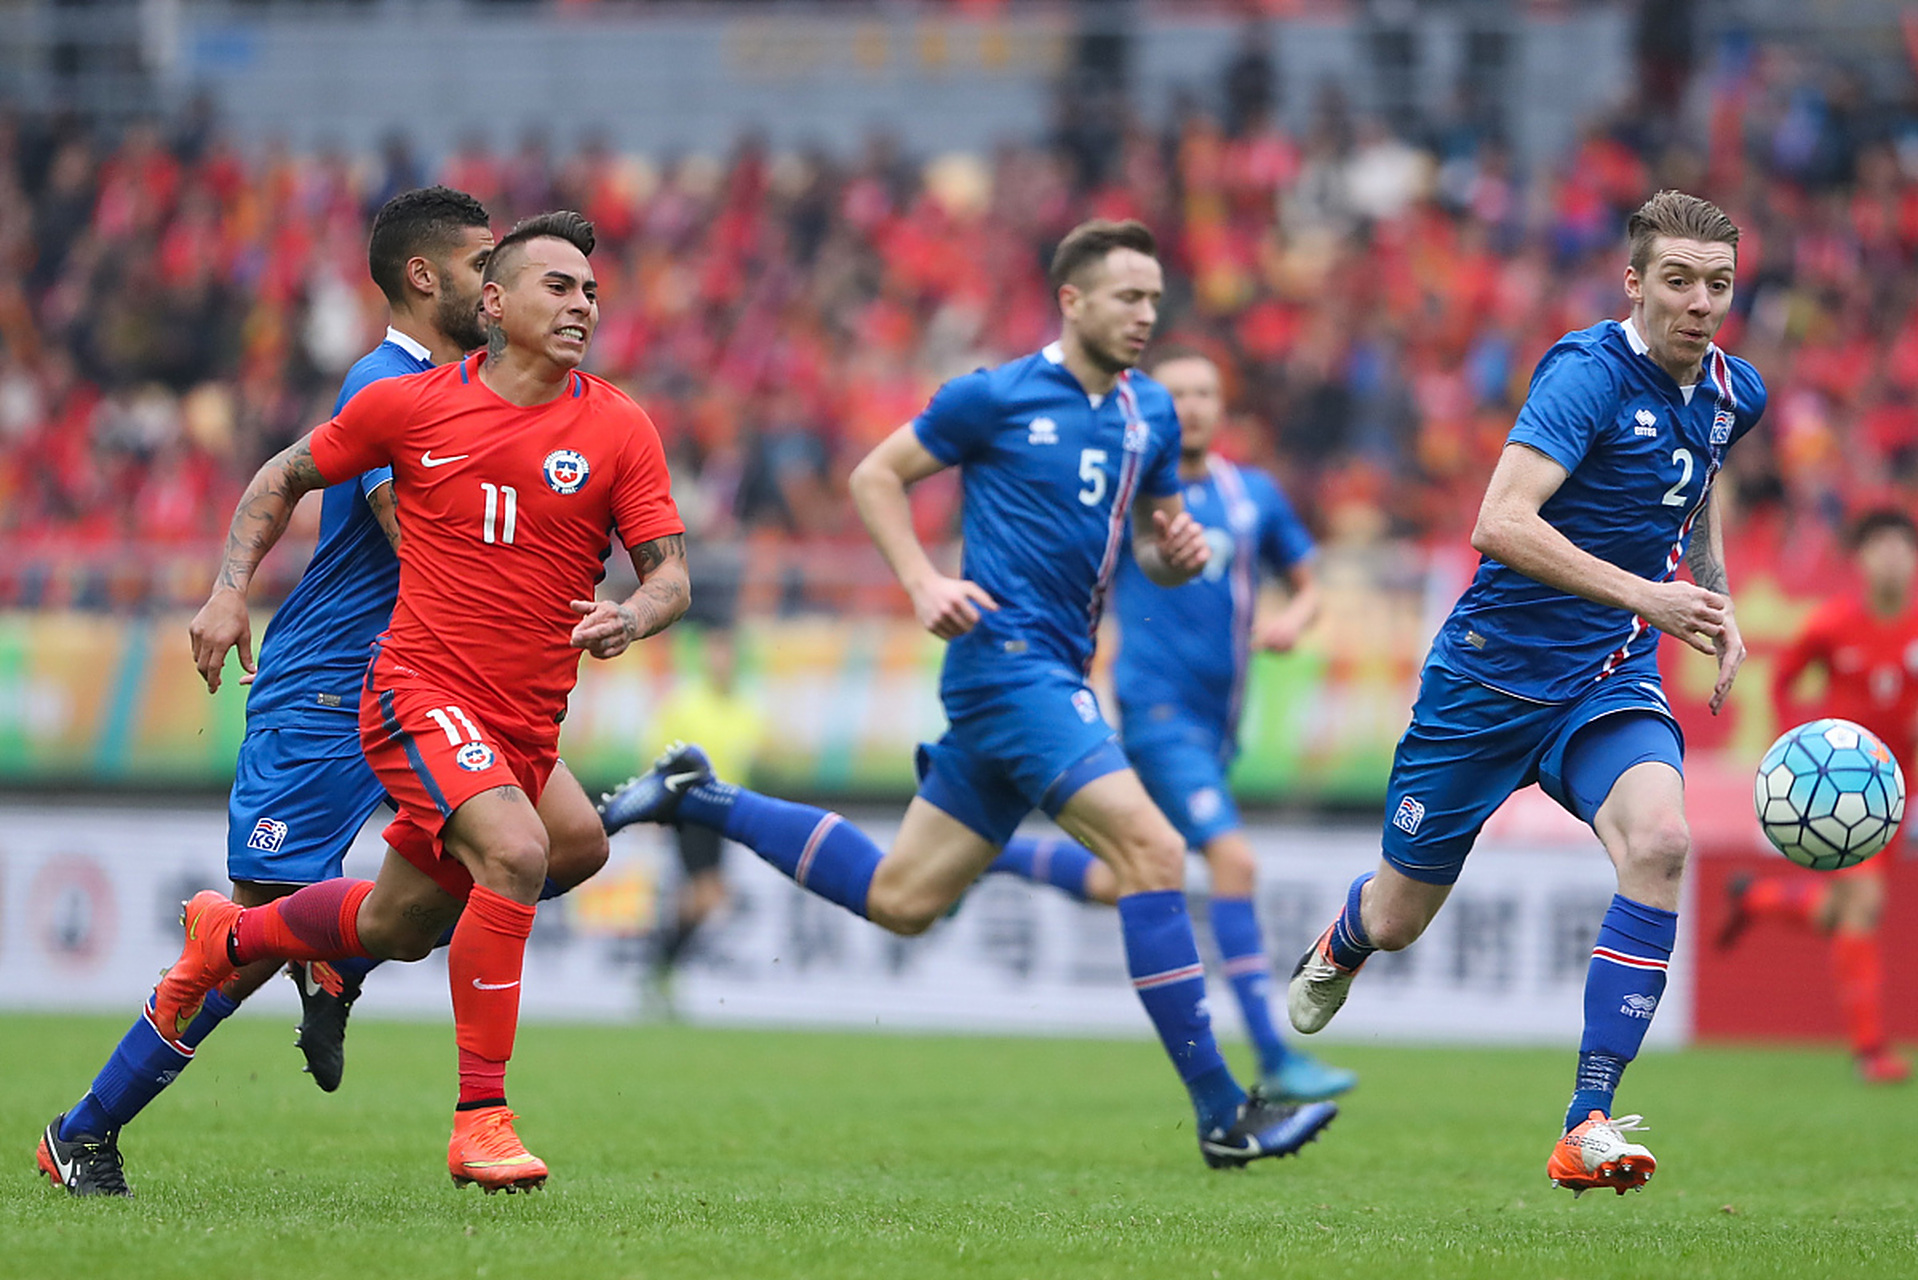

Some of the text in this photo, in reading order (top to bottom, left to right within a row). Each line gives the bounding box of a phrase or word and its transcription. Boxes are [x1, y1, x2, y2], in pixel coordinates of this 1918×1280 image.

[1078, 448, 1107, 506] 5
[1661, 448, 1694, 507] 2
[480, 482, 517, 544] 11
[425, 705, 483, 747] 11
